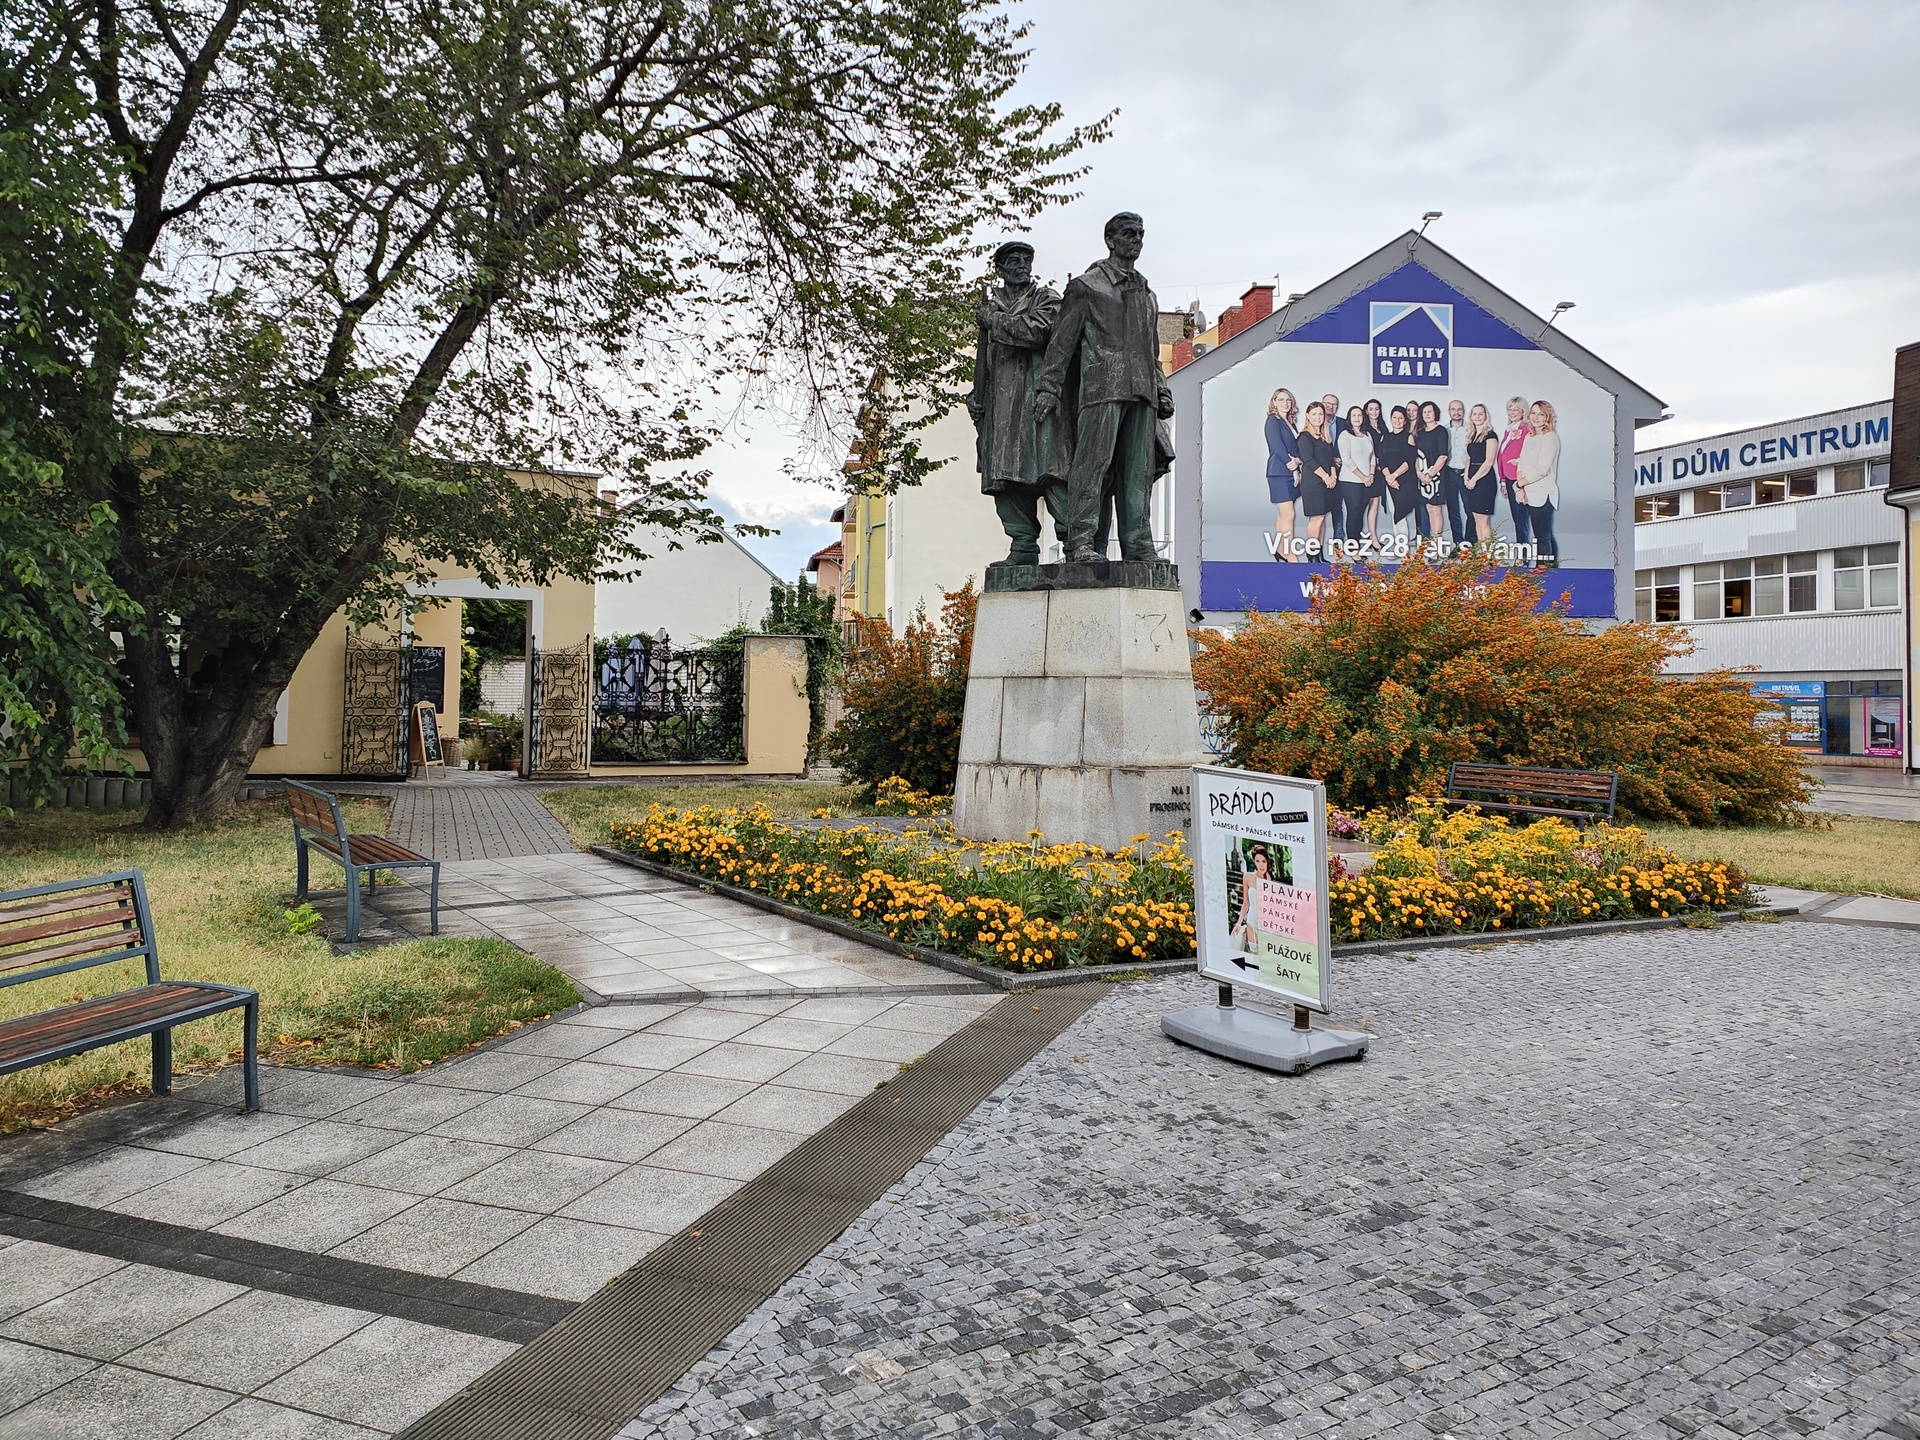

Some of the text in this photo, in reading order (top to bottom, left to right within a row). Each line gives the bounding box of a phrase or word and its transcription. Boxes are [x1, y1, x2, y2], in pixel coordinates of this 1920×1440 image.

[1376, 346, 1445, 359] REALITY
[1380, 360, 1442, 377] GAIA
[1673, 448, 1730, 480] DŮM
[1740, 417, 1889, 467] CENTRUM
[1264, 532, 1321, 555] Více
[1328, 534, 1373, 557] než
[1379, 533, 1409, 557] 28
[1208, 786, 1274, 817] PRÁDLO
[1212, 820, 1306, 844] DÁMSKÉ PÁNSKÉ DĚTSKÉ
[1262, 882, 1312, 902] PLAVKY
[1263, 894, 1299, 910] DÁMSKÉ
[1262, 907, 1296, 923] PÁNSKÉ
[1263, 920, 1295, 936] DĚTSKÉ
[1267, 942, 1312, 965] PLÁŽOVÉ
[1276, 963, 1301, 982] ŠATY
